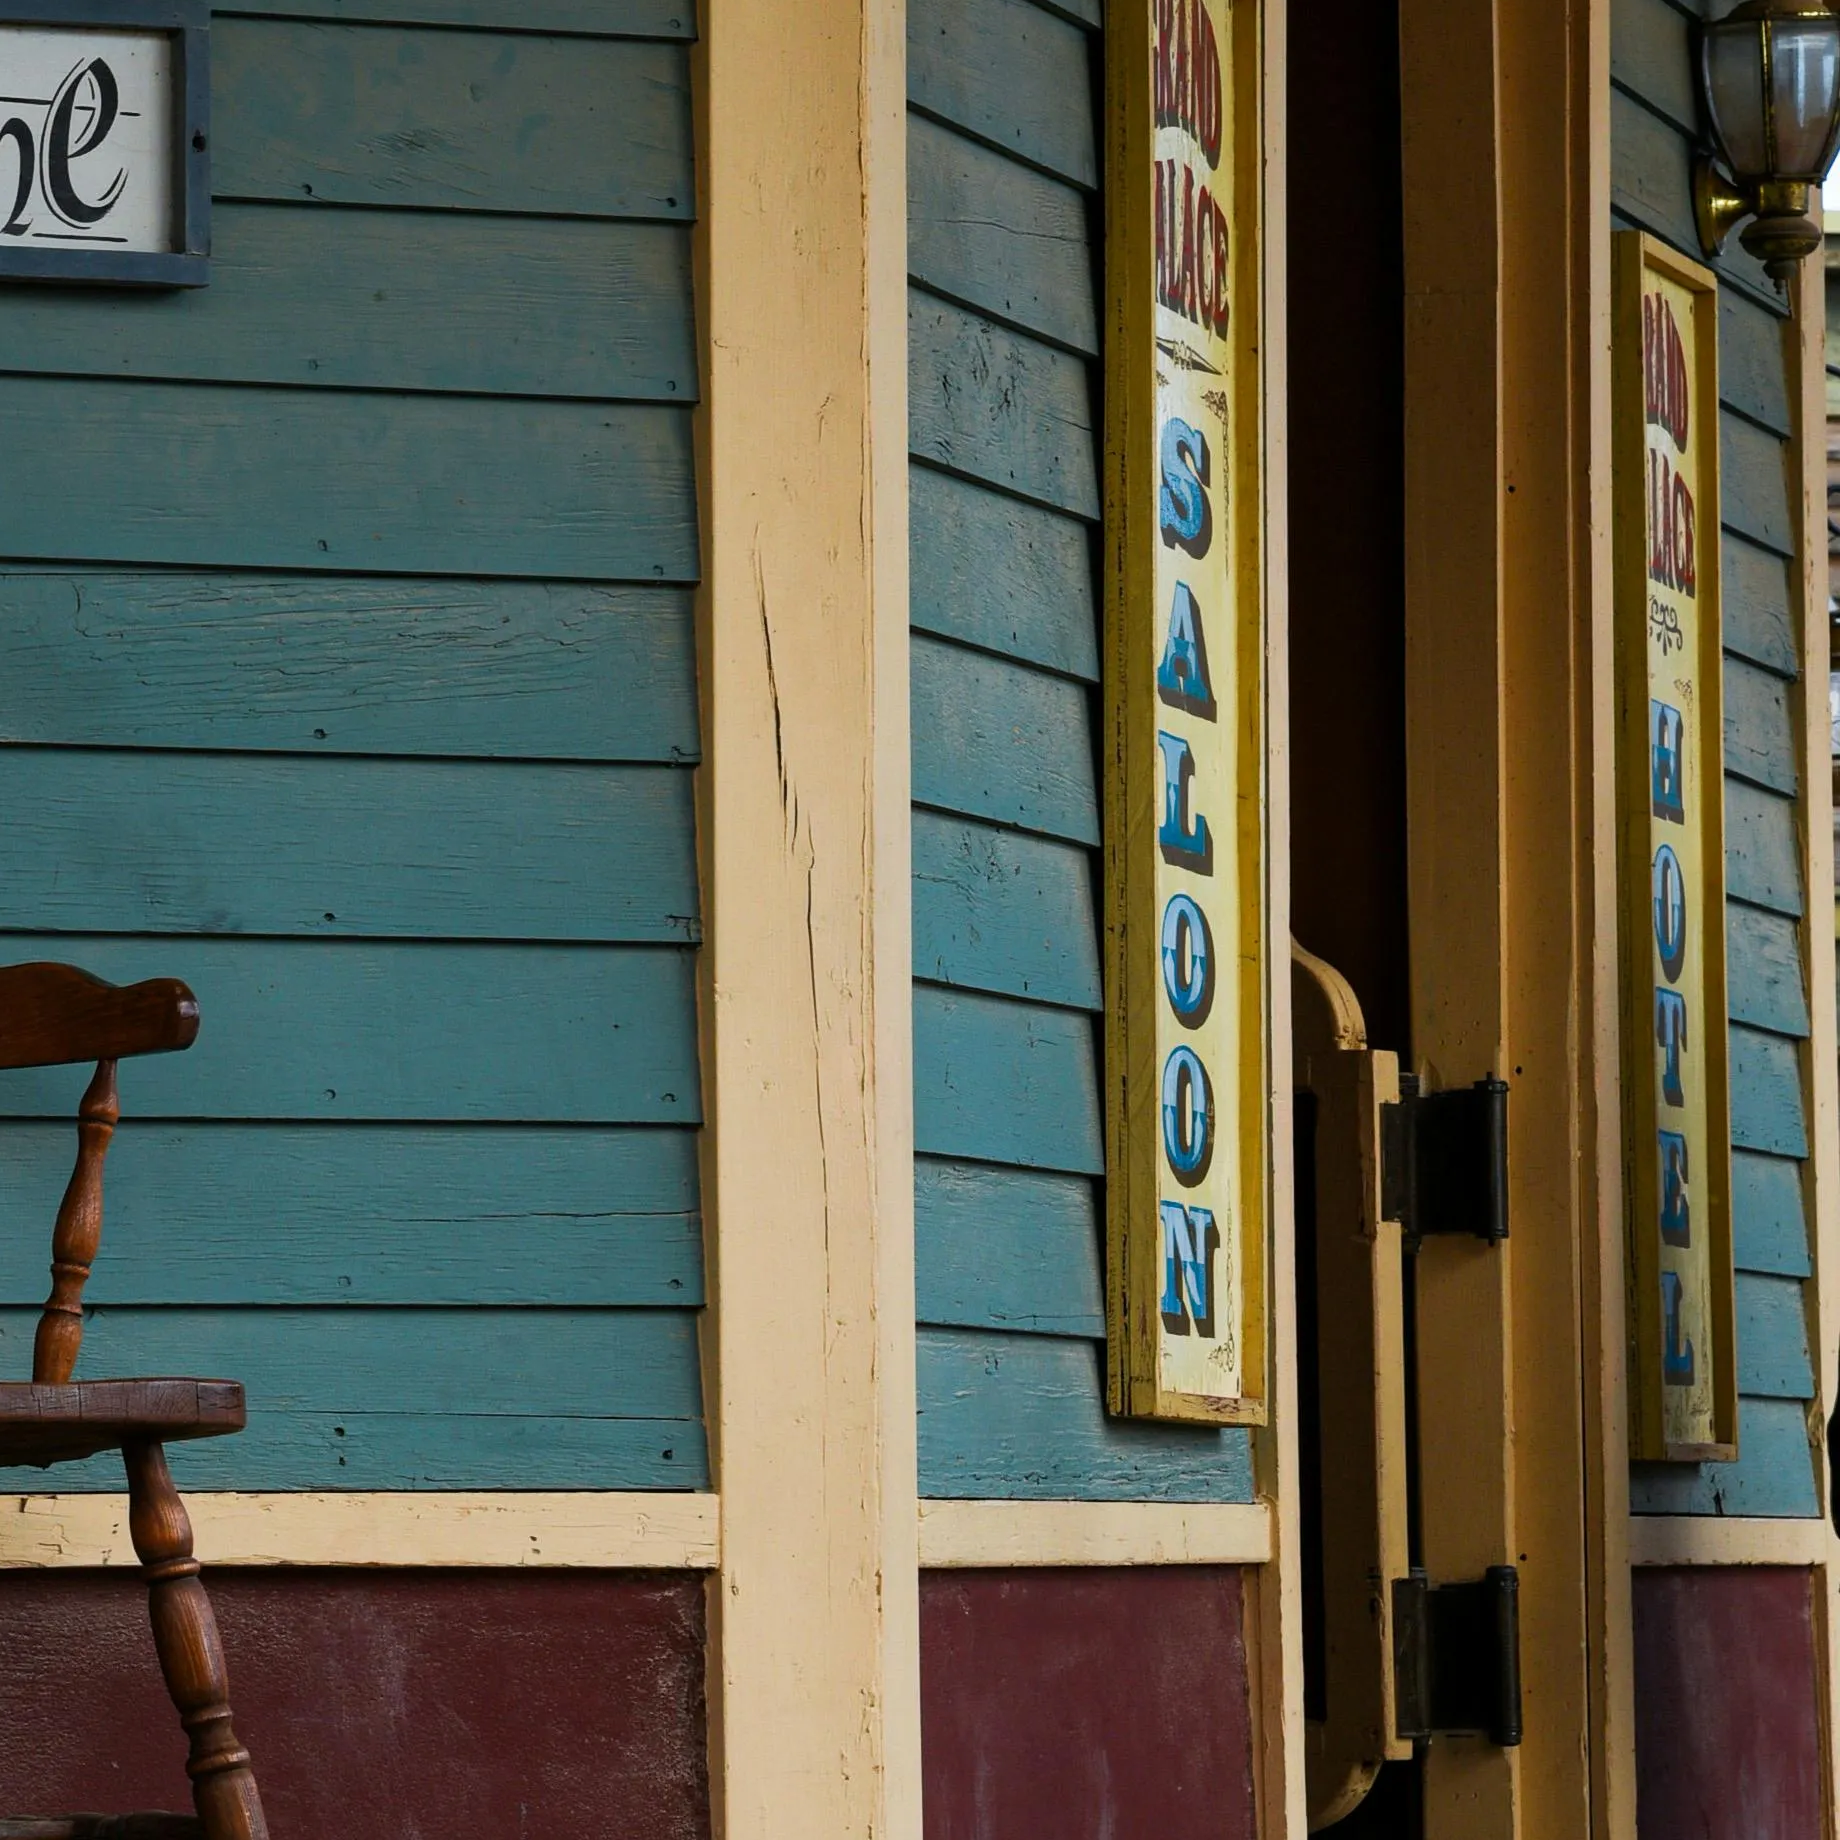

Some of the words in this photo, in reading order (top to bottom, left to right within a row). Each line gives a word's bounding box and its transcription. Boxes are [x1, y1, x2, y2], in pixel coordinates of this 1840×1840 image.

[1154, 158, 1230, 342] ALACE
[1158, 415, 1220, 1339] SALOON
[1650, 698, 1695, 1387] HOTEL
